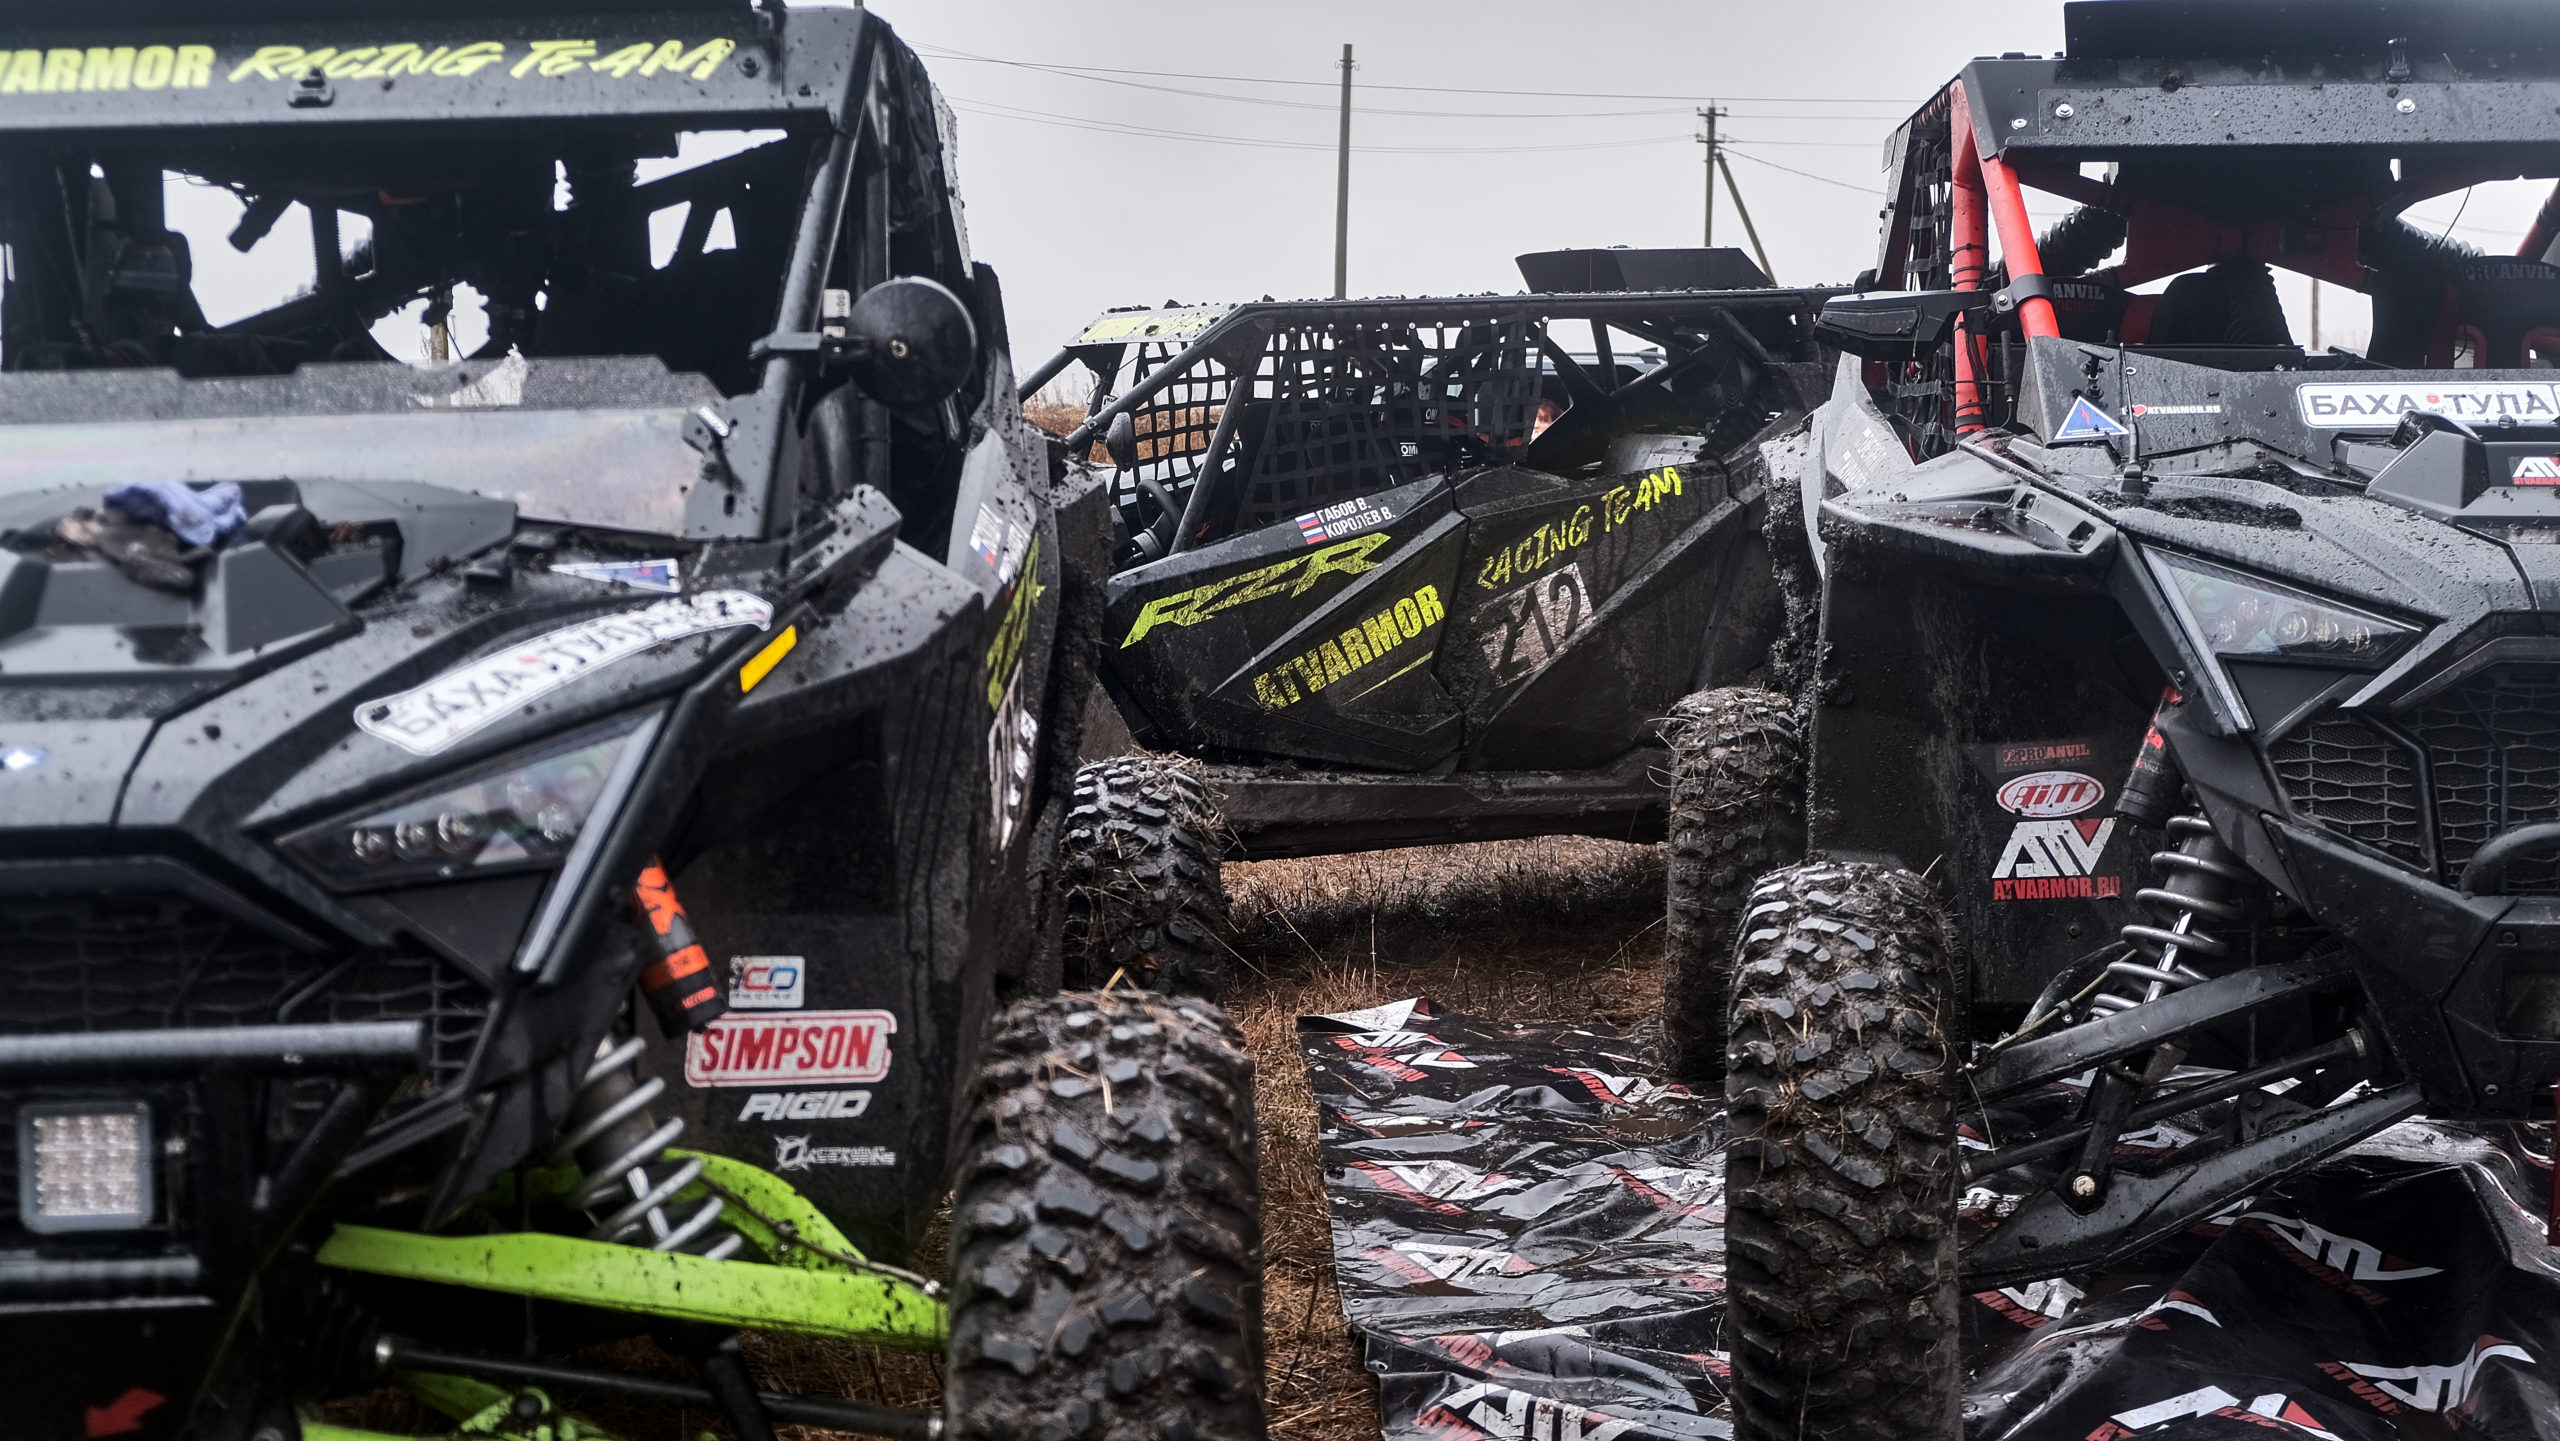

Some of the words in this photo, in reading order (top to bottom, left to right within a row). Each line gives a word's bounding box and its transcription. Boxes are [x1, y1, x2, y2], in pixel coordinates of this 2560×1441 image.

[227, 45, 505, 83] RACING
[509, 38, 736, 80] TEAM
[2309, 394, 2417, 416] БАХА
[2443, 394, 2556, 416] ТУЛА
[1316, 501, 1357, 523] ГАБОВ
[1355, 497, 1372, 511] В.
[1601, 467, 1682, 533] TEAM
[1323, 510, 1382, 538] КОРОЛЕВ
[1380, 506, 1396, 521] В.
[1253, 584, 1446, 713] ATVARMOR
[1994, 876, 2121, 900] ATVARMOR.RU
[700, 1025, 876, 1073] SIMPSON
[737, 1090, 872, 1122] RIGID
